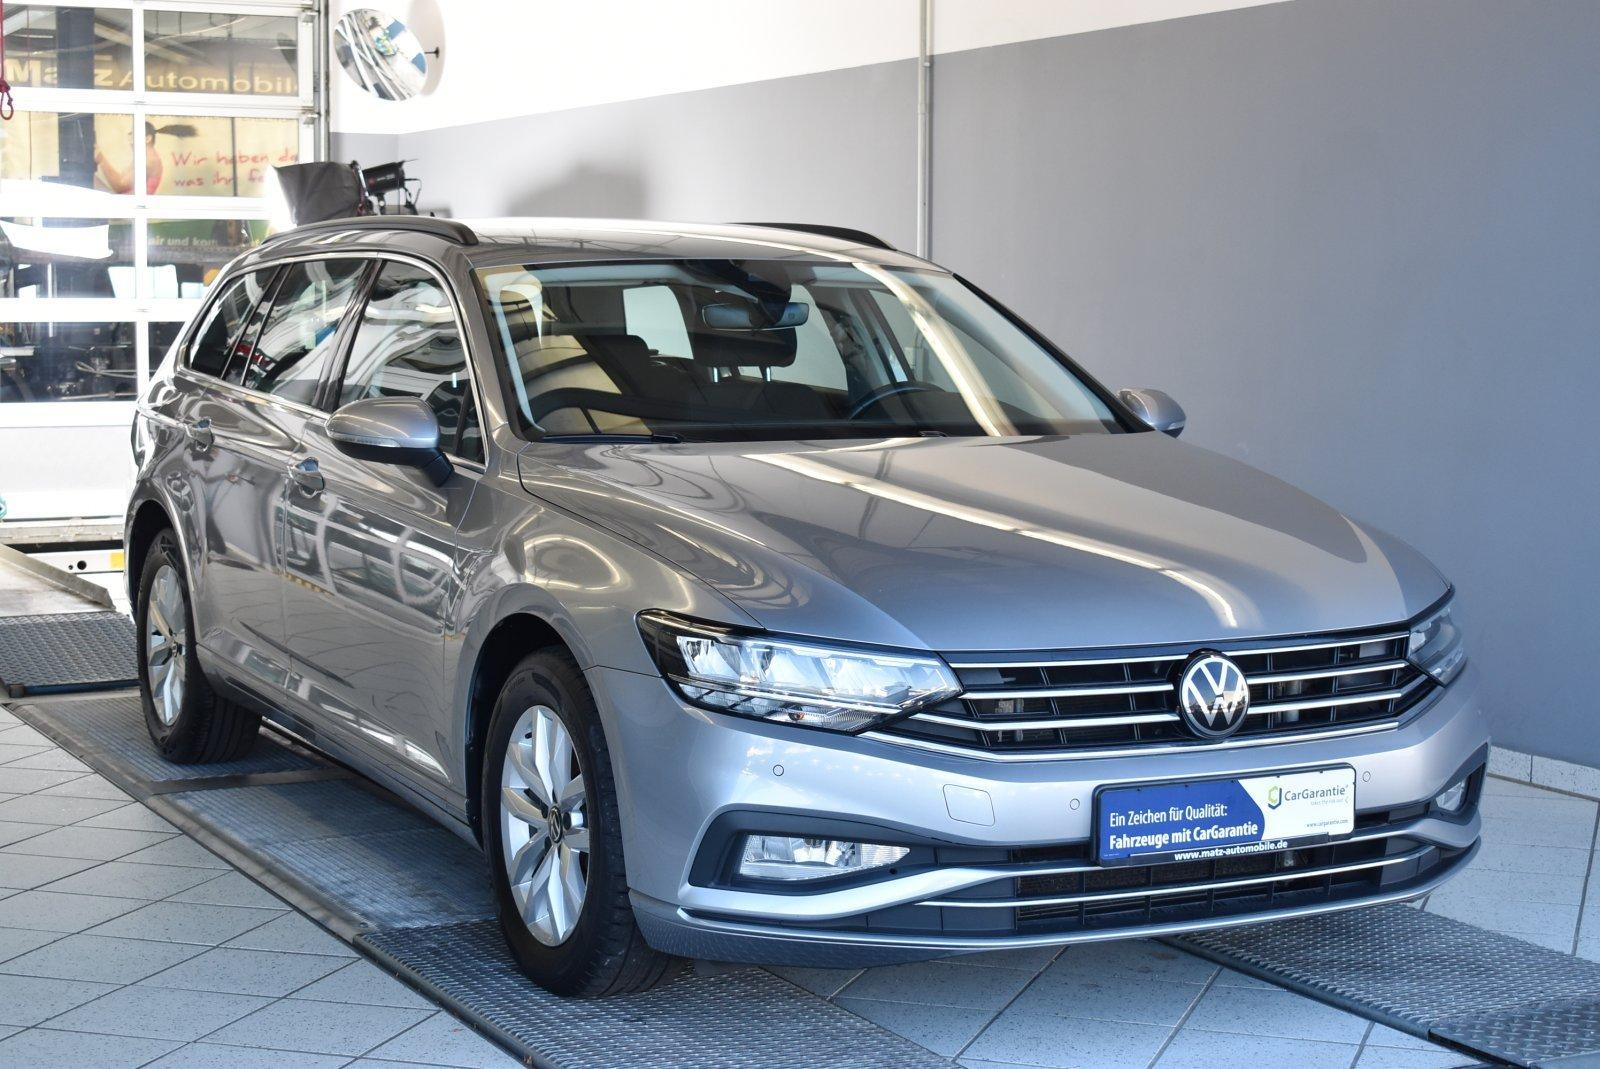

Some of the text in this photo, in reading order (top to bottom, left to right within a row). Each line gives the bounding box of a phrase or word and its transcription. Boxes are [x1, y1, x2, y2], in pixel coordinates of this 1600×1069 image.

[5, 58, 298, 94] Maz Automobil
[172, 150, 208, 166] Wir
[278, 147, 299, 163] da
[174, 176, 204, 187] was
[1182, 656, 1249, 736] VW
[1284, 785, 1346, 801] CarGarantie
[1109, 803, 1229, 828] Ein Zeichen für Qualität:
[1109, 820, 1259, 850] Fahrzeuge mit CarGarantie
[1174, 840, 1288, 861] www.matz-automobile.de
